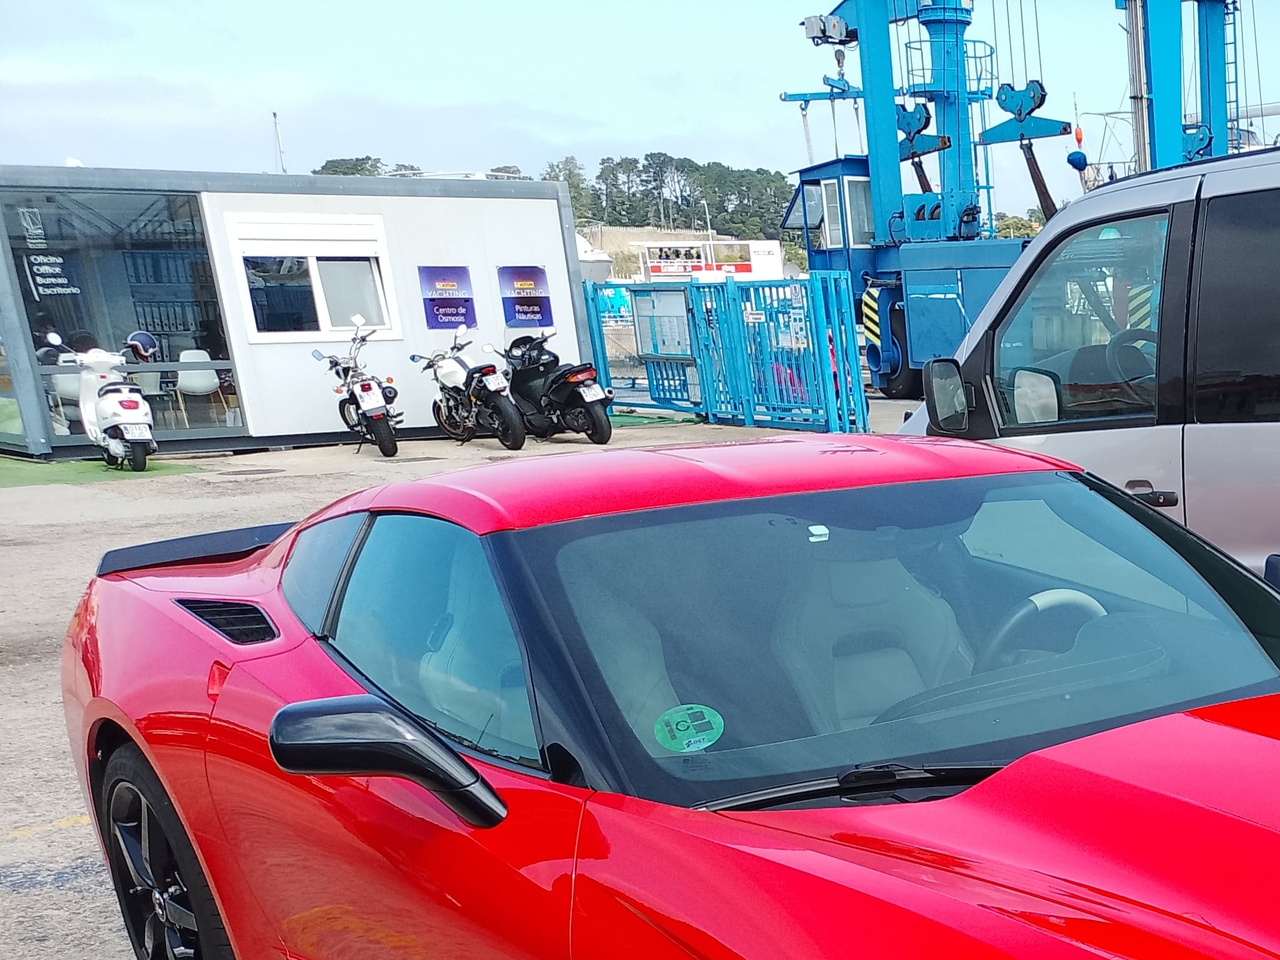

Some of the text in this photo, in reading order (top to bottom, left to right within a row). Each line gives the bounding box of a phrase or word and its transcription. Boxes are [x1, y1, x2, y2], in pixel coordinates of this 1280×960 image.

[30, 255, 64, 264] Oficina
[33, 265, 62, 274] Office
[35, 275, 68, 284] Bureau
[38, 286, 81, 295] Escritorio
[427, 290, 469, 298] YACHTING
[433, 306, 467, 314] Centro de
[515, 304, 541, 312] Pinturas
[438, 314, 466, 323] Osmosis
